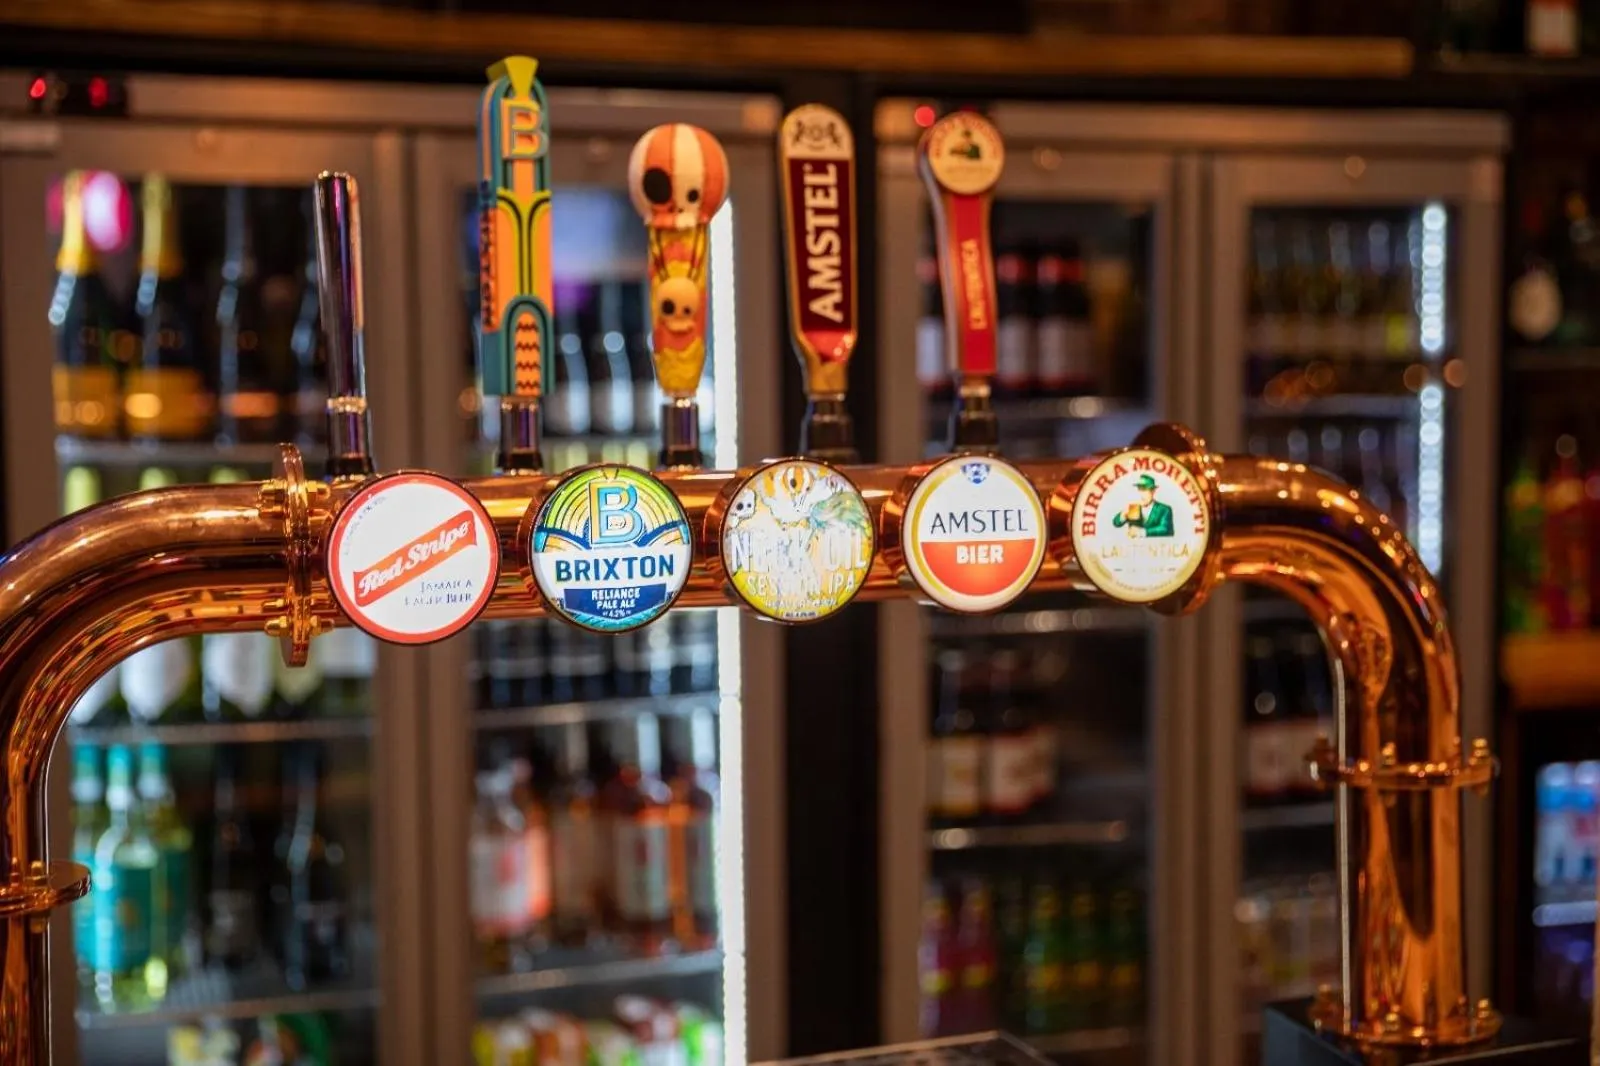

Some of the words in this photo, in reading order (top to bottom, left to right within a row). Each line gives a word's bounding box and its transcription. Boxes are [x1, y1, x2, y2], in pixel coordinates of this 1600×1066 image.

[500, 97, 549, 159] B
[803, 162, 844, 323] AMSTEL
[1082, 462, 1128, 536] BIRRA
[1132, 456, 1205, 535] MORETTI
[589, 480, 643, 545] B
[930, 509, 1028, 535] AMSTEL
[358, 556, 404, 597] Red
[405, 520, 471, 569] Stripe
[555, 554, 674, 582] BRIXTON
[956, 544, 1004, 565] BIER
[591, 587, 641, 601] RELIANCE
[829, 570, 855, 594] IPA
[596, 600, 618, 609] PALE
[620, 600, 636, 609] ALE
